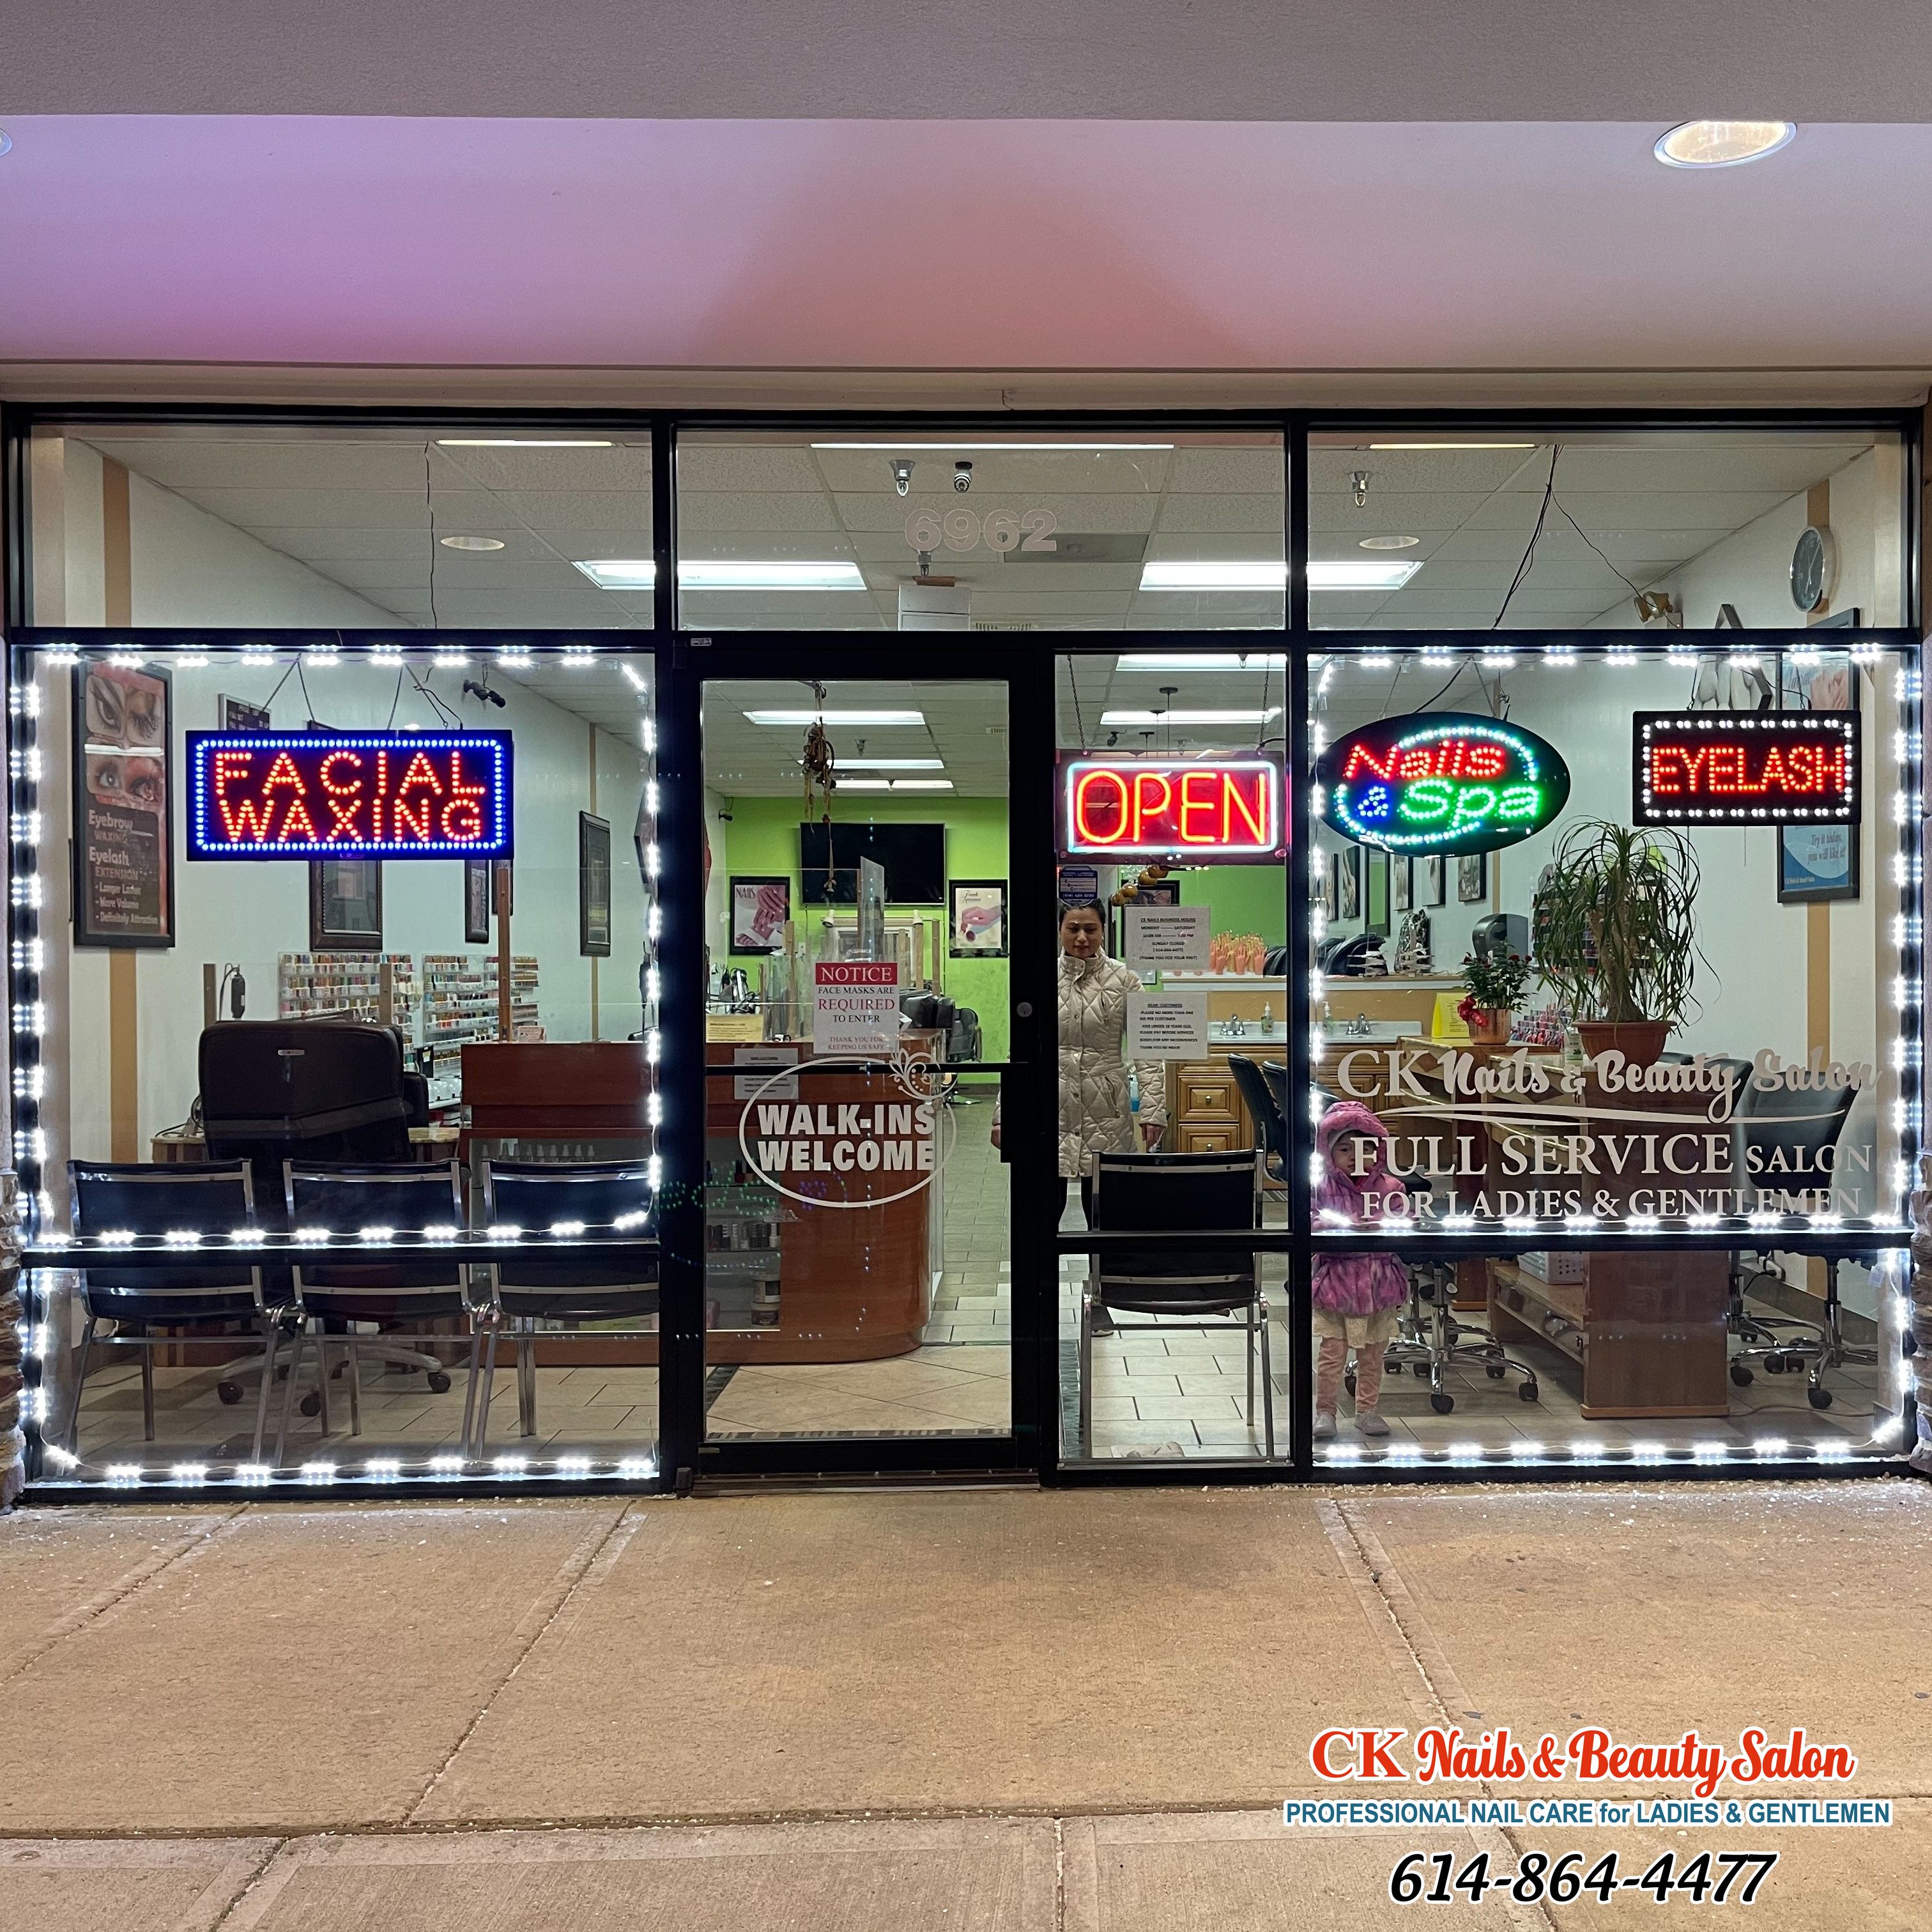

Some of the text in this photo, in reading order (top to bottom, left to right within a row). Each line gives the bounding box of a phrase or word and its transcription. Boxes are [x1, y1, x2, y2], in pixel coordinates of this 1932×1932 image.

[905, 509, 1057, 552] 6962
[215, 751, 486, 796] FACIAL
[1343, 739, 1505, 779] Nails
[1652, 746, 1844, 792] EYELASH
[88, 809, 134, 830] Eyebrow
[218, 798, 482, 843] WAXING
[1076, 770, 1268, 845] OPEN
[1358, 779, 1540, 828] & Spa
[89, 846, 130, 866] Eyelash
[735, 887, 756, 900] NAILS
[820, 967, 893, 982] NOTICE
[818, 999, 895, 1012] REQUIRED
[832, 1015, 880, 1023] TO ENTER
[1337, 1046, 1883, 1123] CK Nails & Beauty Salon
[757, 1104, 936, 1136] WALK-INS
[757, 1140, 935, 1172] WELCOME
[1349, 1133, 1873, 1176] FULL SERVICE SALON
[1360, 1188, 1862, 1218] FOR LADIES & GENTLEMEN
